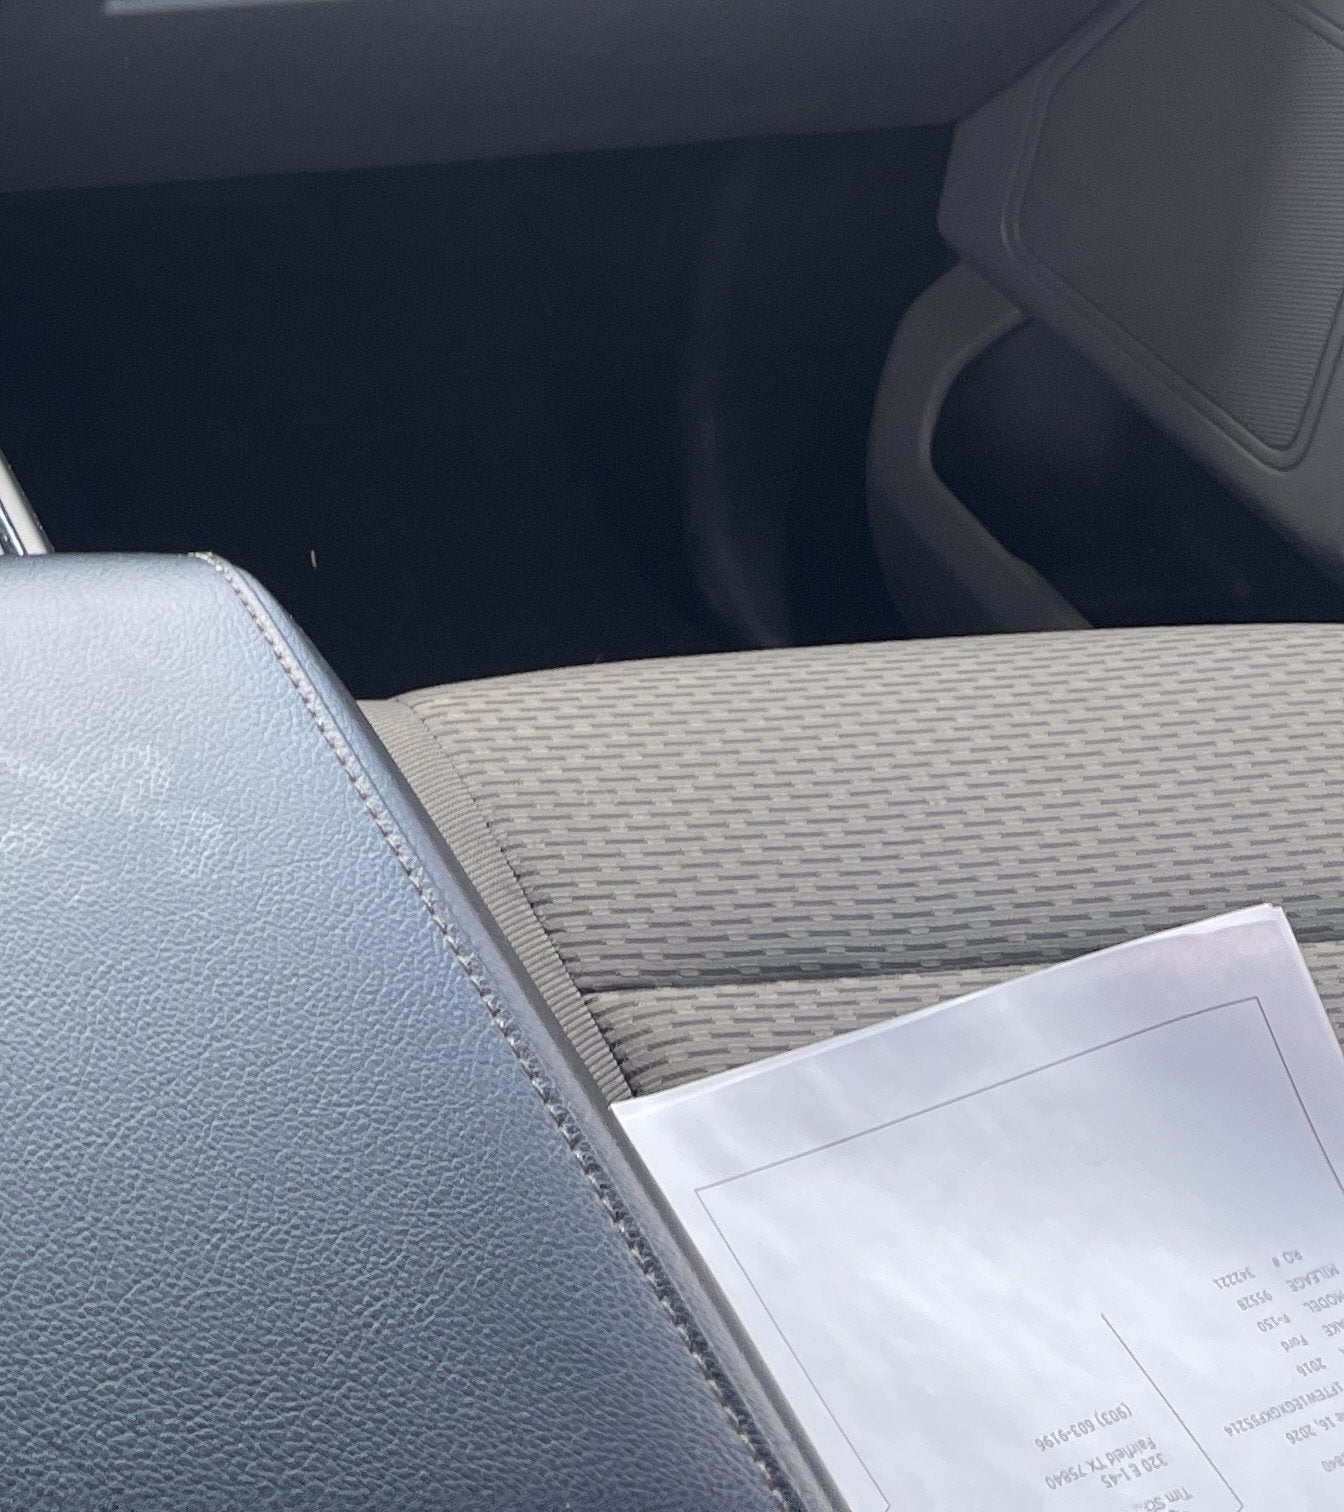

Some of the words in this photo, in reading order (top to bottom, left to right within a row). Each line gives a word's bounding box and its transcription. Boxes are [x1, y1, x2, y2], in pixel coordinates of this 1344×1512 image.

[1286, 1263, 1340, 1292] MILEAGE
[1257, 1312, 1291, 1332] F-150
[1281, 1334, 1309, 1353] Ford
[1094, 1402, 1133, 1429] (903)
[1034, 1418, 1096, 1452] 603-9196
[1105, 1436, 1157, 1467] Fairfield
[1086, 1456, 1108, 1473] TX
[1128, 1463, 1142, 1478] E
[1140, 1452, 1169, 1473] 320
[1045, 1464, 1088, 1490] 75840
[1164, 1486, 1194, 1507] Tim
